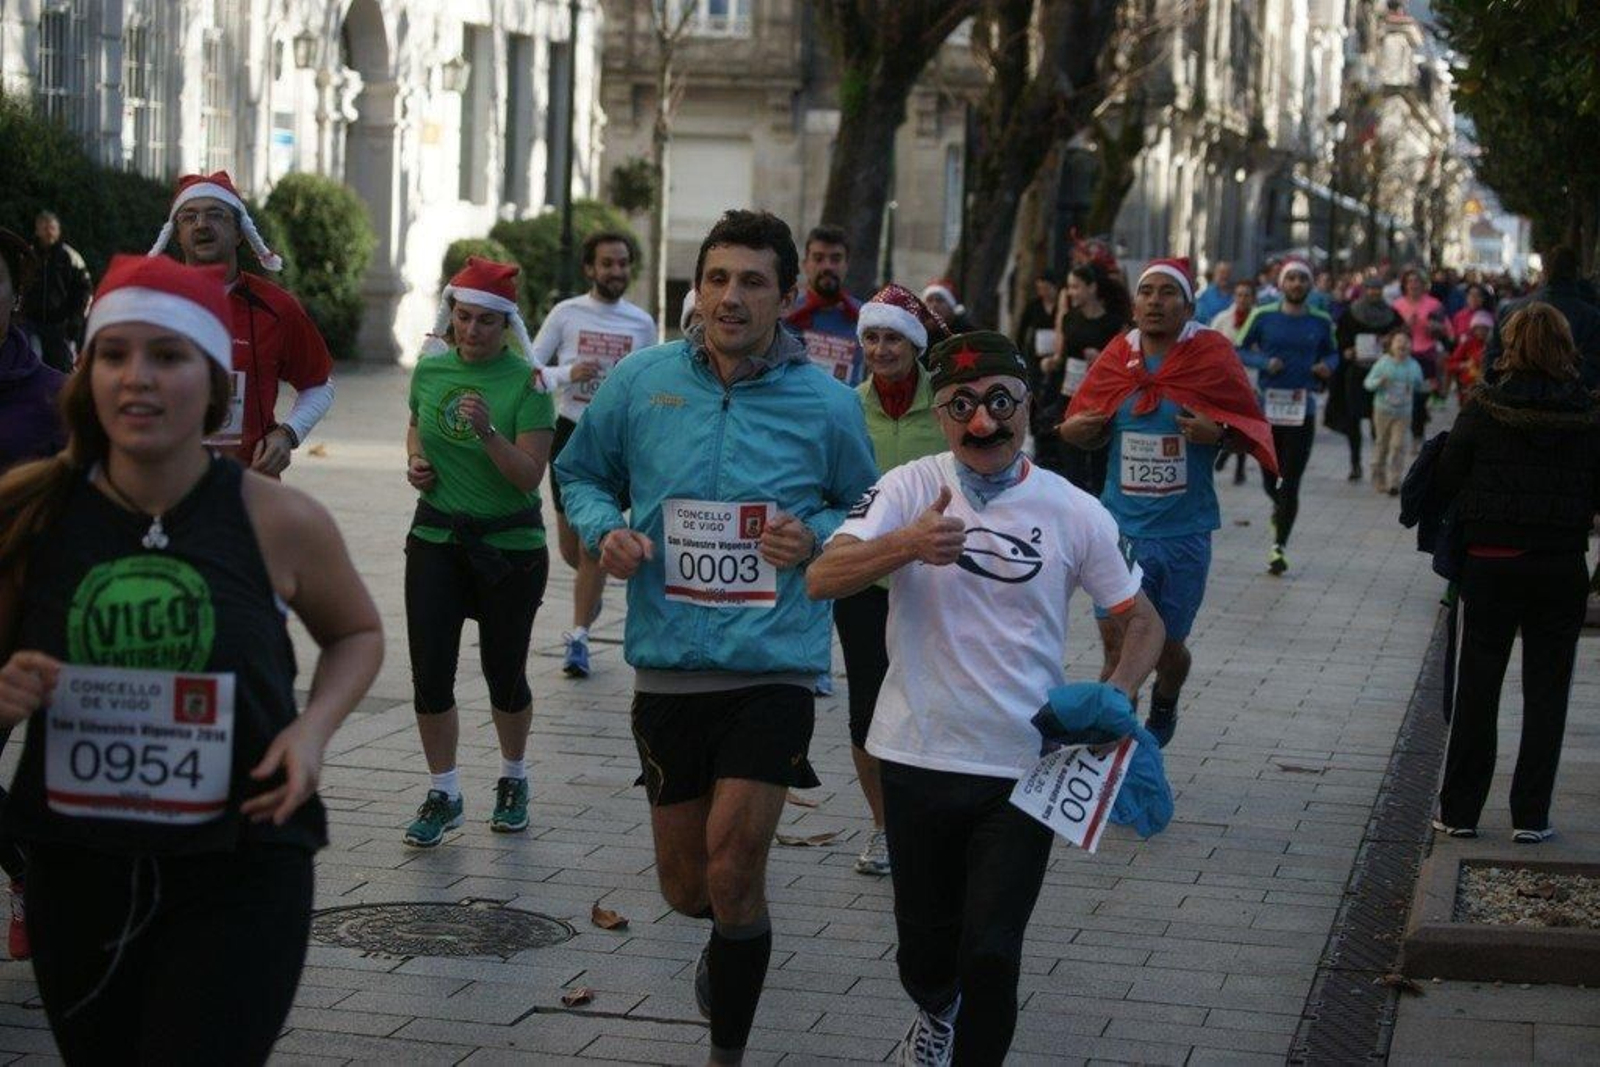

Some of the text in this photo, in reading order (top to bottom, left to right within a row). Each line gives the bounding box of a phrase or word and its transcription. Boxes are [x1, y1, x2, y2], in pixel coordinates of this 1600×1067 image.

[1129, 464, 1177, 483] 1253
[677, 508, 732, 522] CONCELLO
[683, 521, 725, 532] DE VIGO
[667, 535, 681, 546] San
[679, 552, 760, 584] 0003
[90, 595, 198, 647] VIGO
[69, 678, 162, 697] CONCELLO
[81, 696, 151, 712] DE VIGO
[52, 717, 75, 731] San
[69, 740, 204, 789] 0954
[1034, 779, 1046, 794] DE
